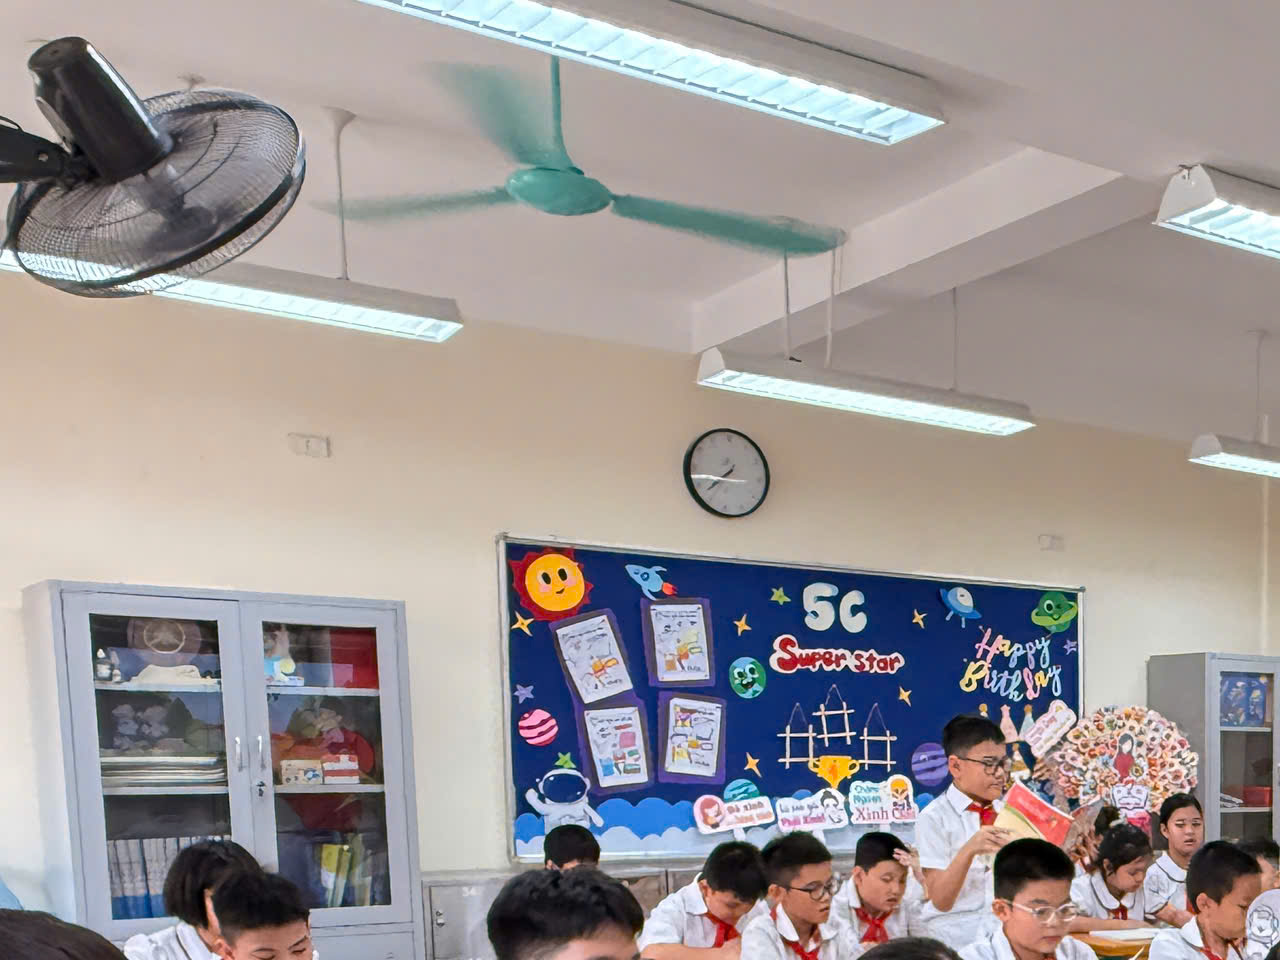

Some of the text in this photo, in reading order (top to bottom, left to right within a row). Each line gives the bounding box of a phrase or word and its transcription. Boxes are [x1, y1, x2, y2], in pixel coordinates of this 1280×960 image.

[803, 582, 867, 633] 5C
[776, 636, 901, 672] Super star
[975, 627, 1051, 669] Happy
[960, 660, 1062, 701] Birthday
[855, 806, 889, 820] Xinh
